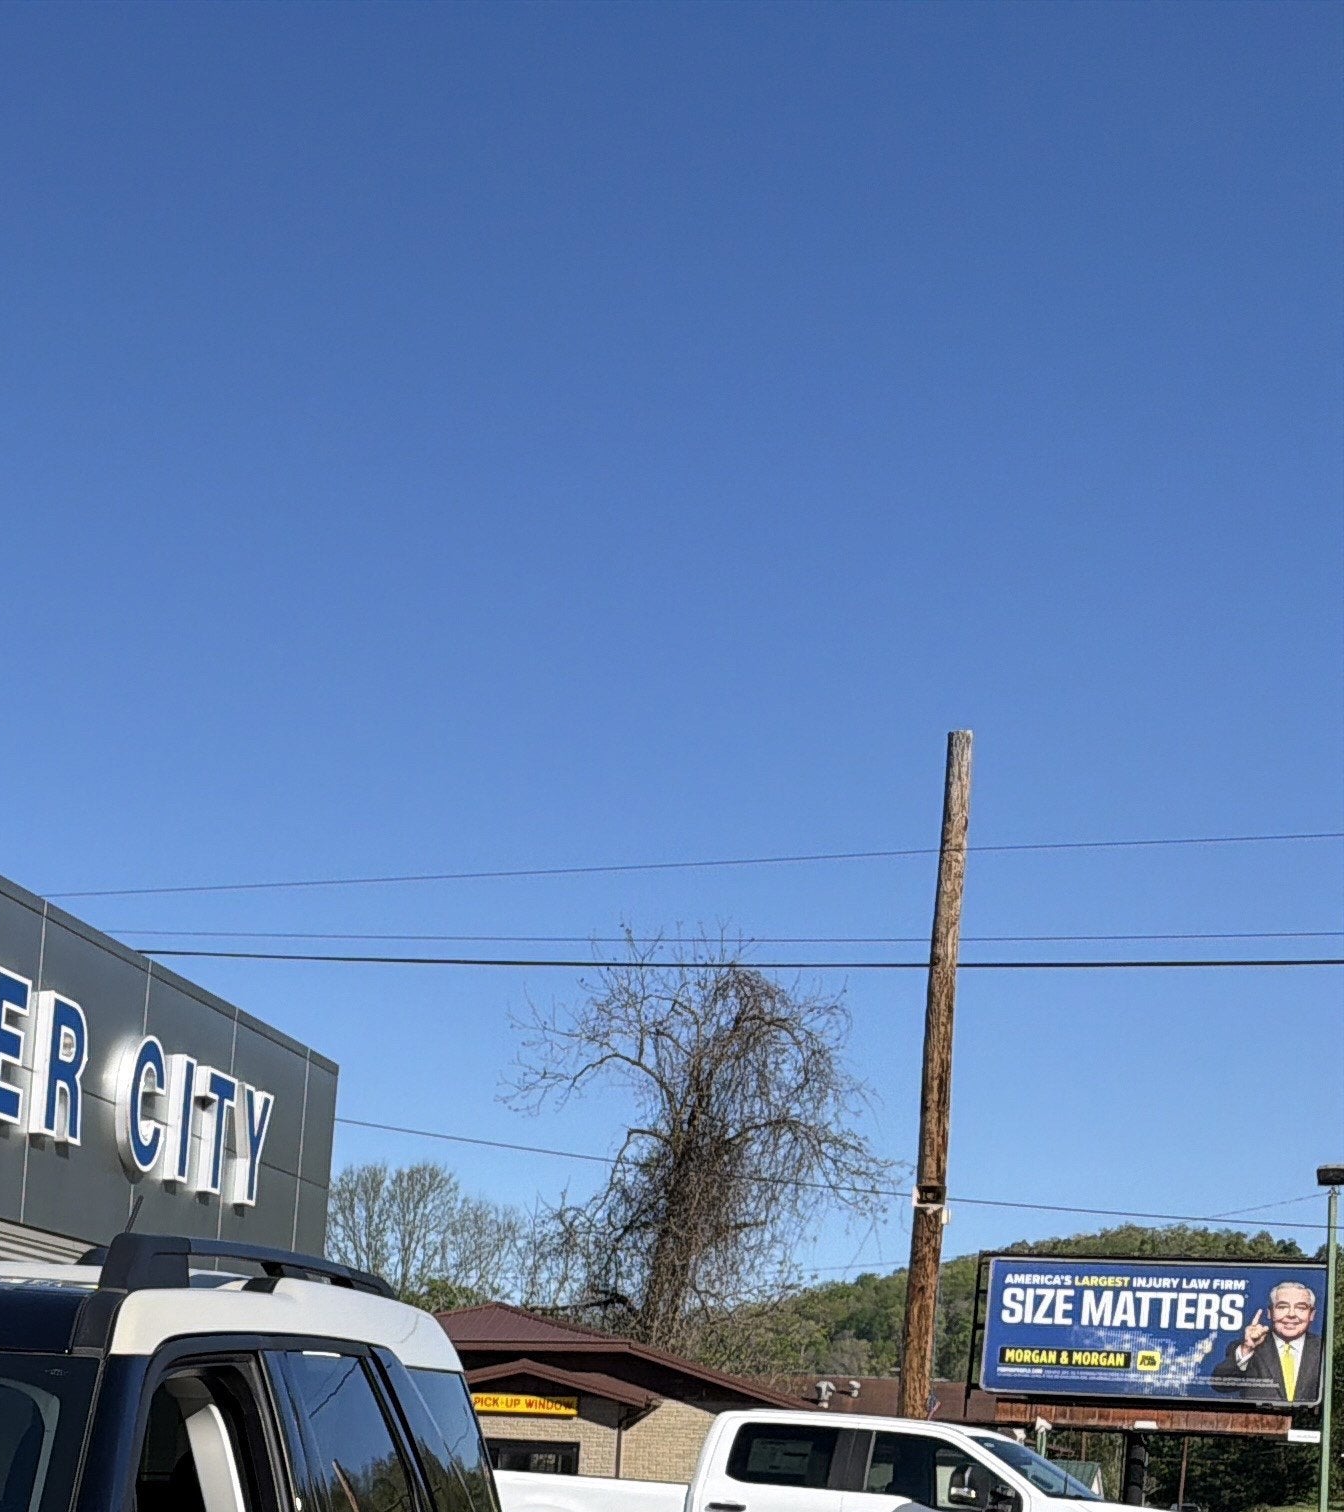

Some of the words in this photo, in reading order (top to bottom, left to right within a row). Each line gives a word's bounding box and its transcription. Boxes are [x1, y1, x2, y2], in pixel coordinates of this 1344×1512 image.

[117, 1035, 275, 1207] CITY
[1004, 1273, 1072, 1286] AMERICA'S
[1074, 1275, 1131, 1288] LARGEST
[1132, 1277, 1179, 1289] INJURY
[1181, 1278, 1211, 1290] LAW
[1001, 1287, 1075, 1326] SIZE
[1080, 1290, 1246, 1332] MATTERS
[1004, 1348, 1058, 1365] MORGAN
[1059, 1350, 1070, 1365] &
[1072, 1351, 1126, 1368] MORGAN
[473, 1396, 521, 1408] PICK-UP
[525, 1398, 576, 1411] WINDOW
